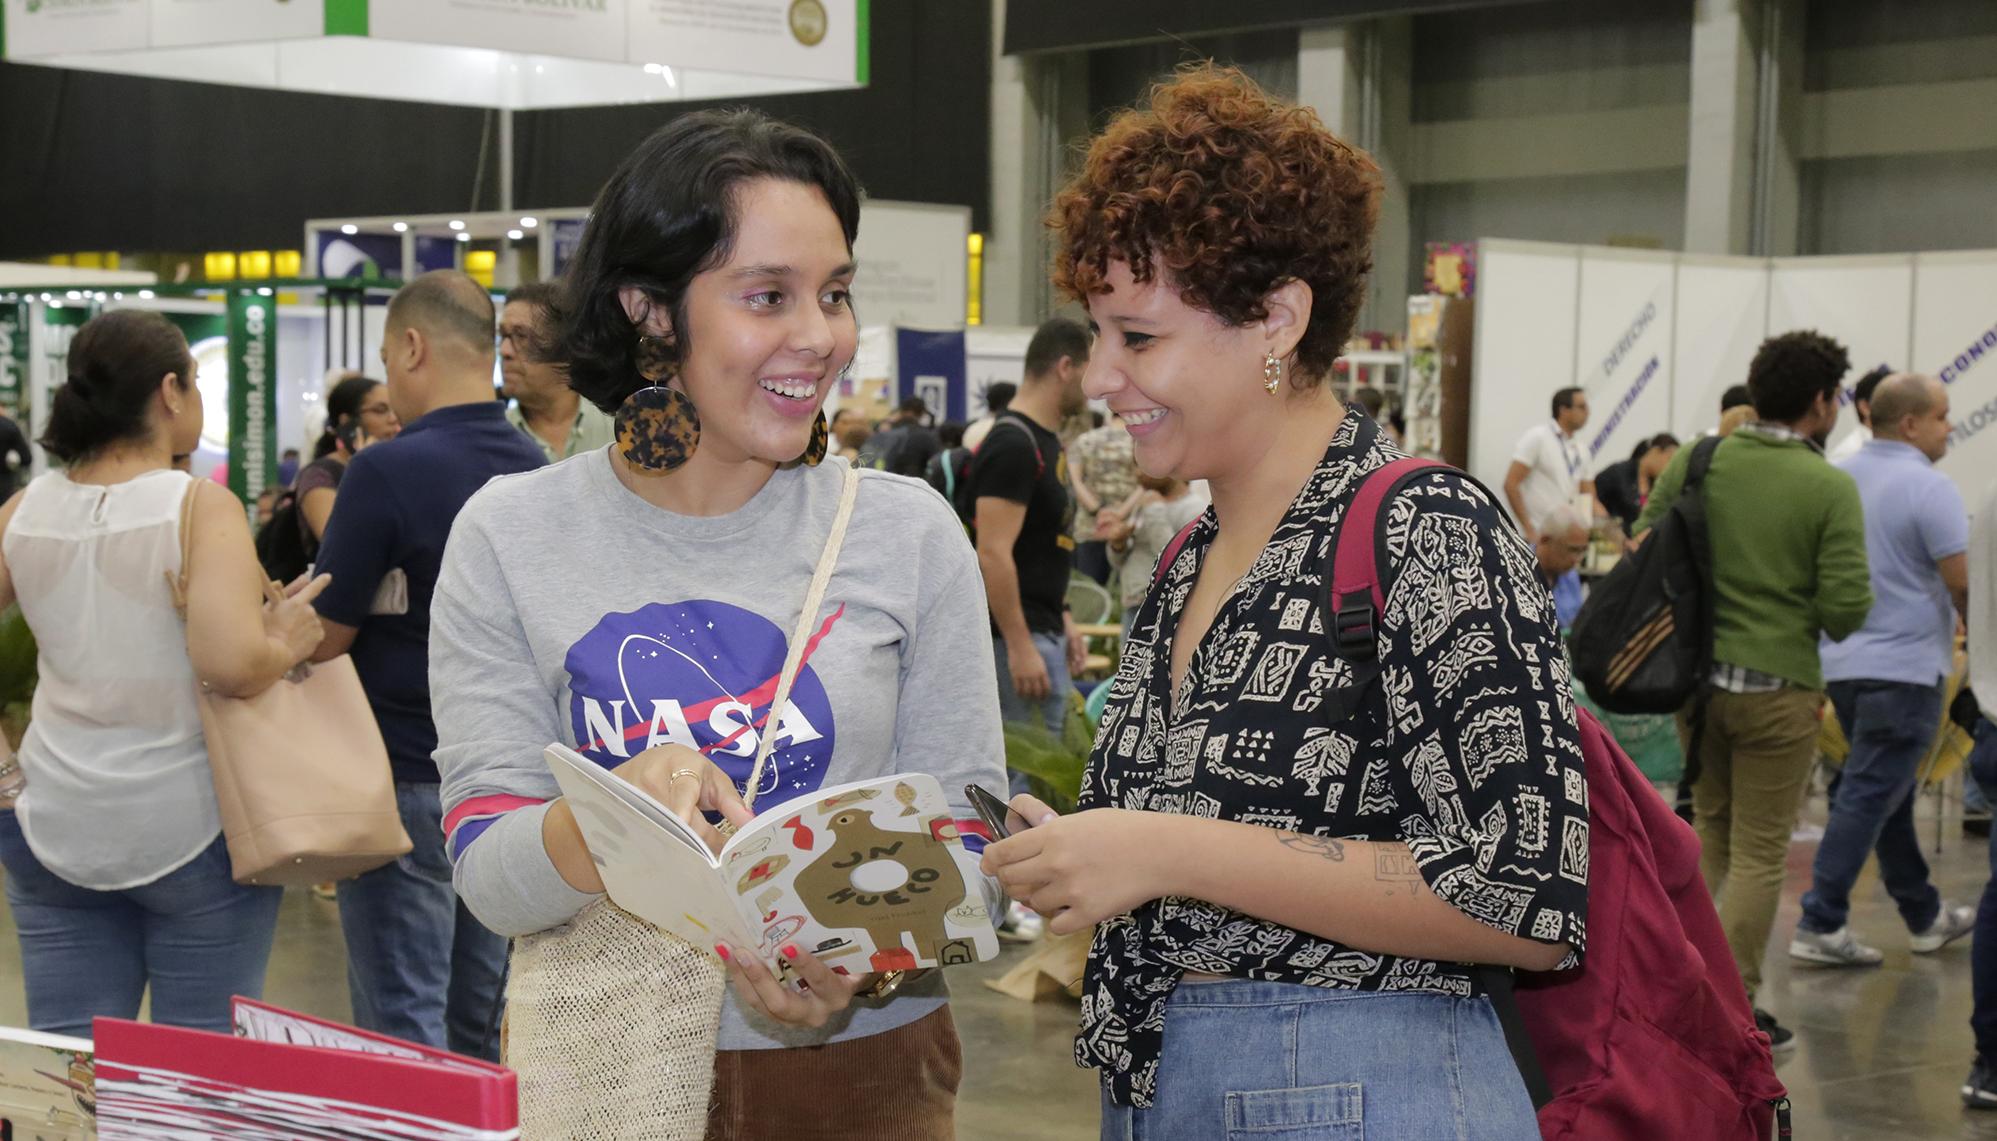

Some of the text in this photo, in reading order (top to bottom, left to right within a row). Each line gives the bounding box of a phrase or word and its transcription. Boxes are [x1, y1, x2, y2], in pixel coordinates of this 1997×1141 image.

[1602, 300, 1657, 377] DERECHO
[1939, 322, 1997, 385] CONO
[243, 304, 266, 525] unisimon.edu.co
[582, 696, 824, 758] NASA
[832, 841, 903, 869] UN
[826, 867, 940, 906] HUECO
